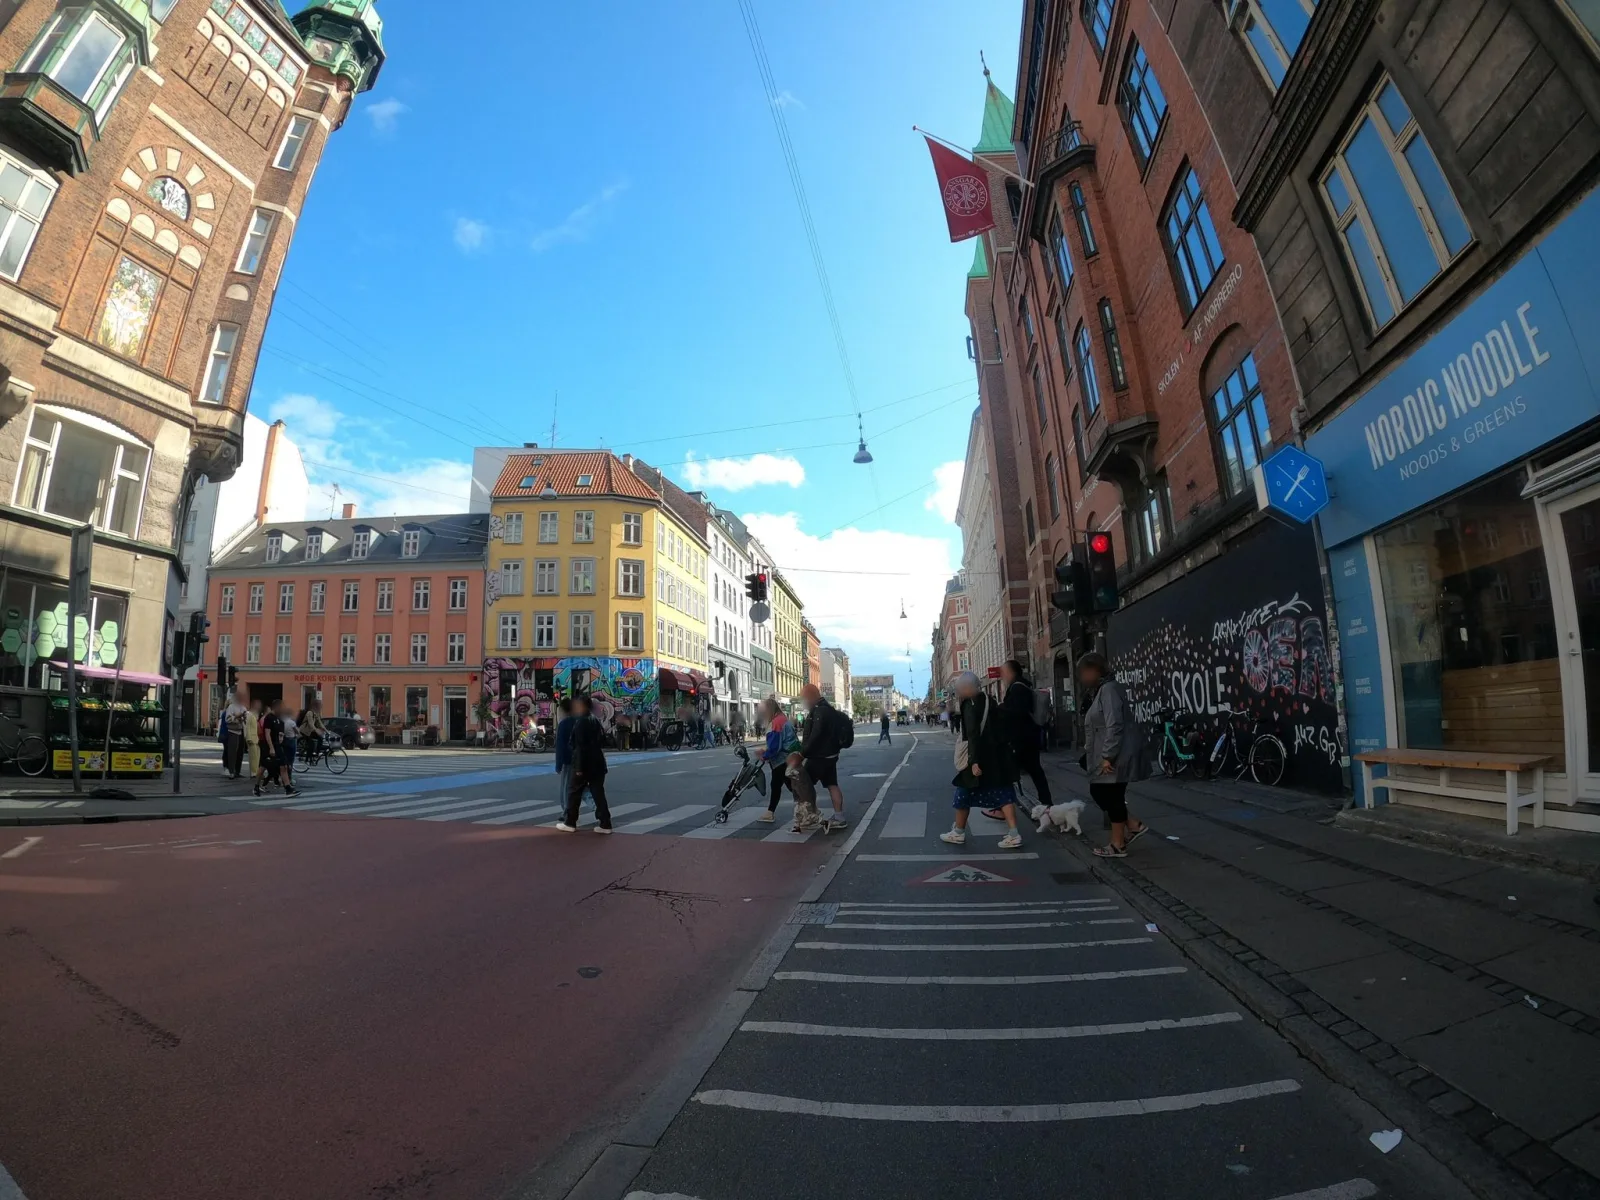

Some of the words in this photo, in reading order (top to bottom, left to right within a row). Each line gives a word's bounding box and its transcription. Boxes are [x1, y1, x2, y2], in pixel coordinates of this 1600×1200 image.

[1193, 323, 1203, 344] AF
[1157, 358, 1180, 396] SKOLEN
[1364, 378, 1447, 471] NORDIC
[1441, 301, 1551, 419] NOODLE
[1399, 443, 1448, 481] NOODS
[1451, 436, 1461, 453] &
[1463, 395, 1527, 445] GREENS
[1170, 665, 1231, 715] SKOLE
